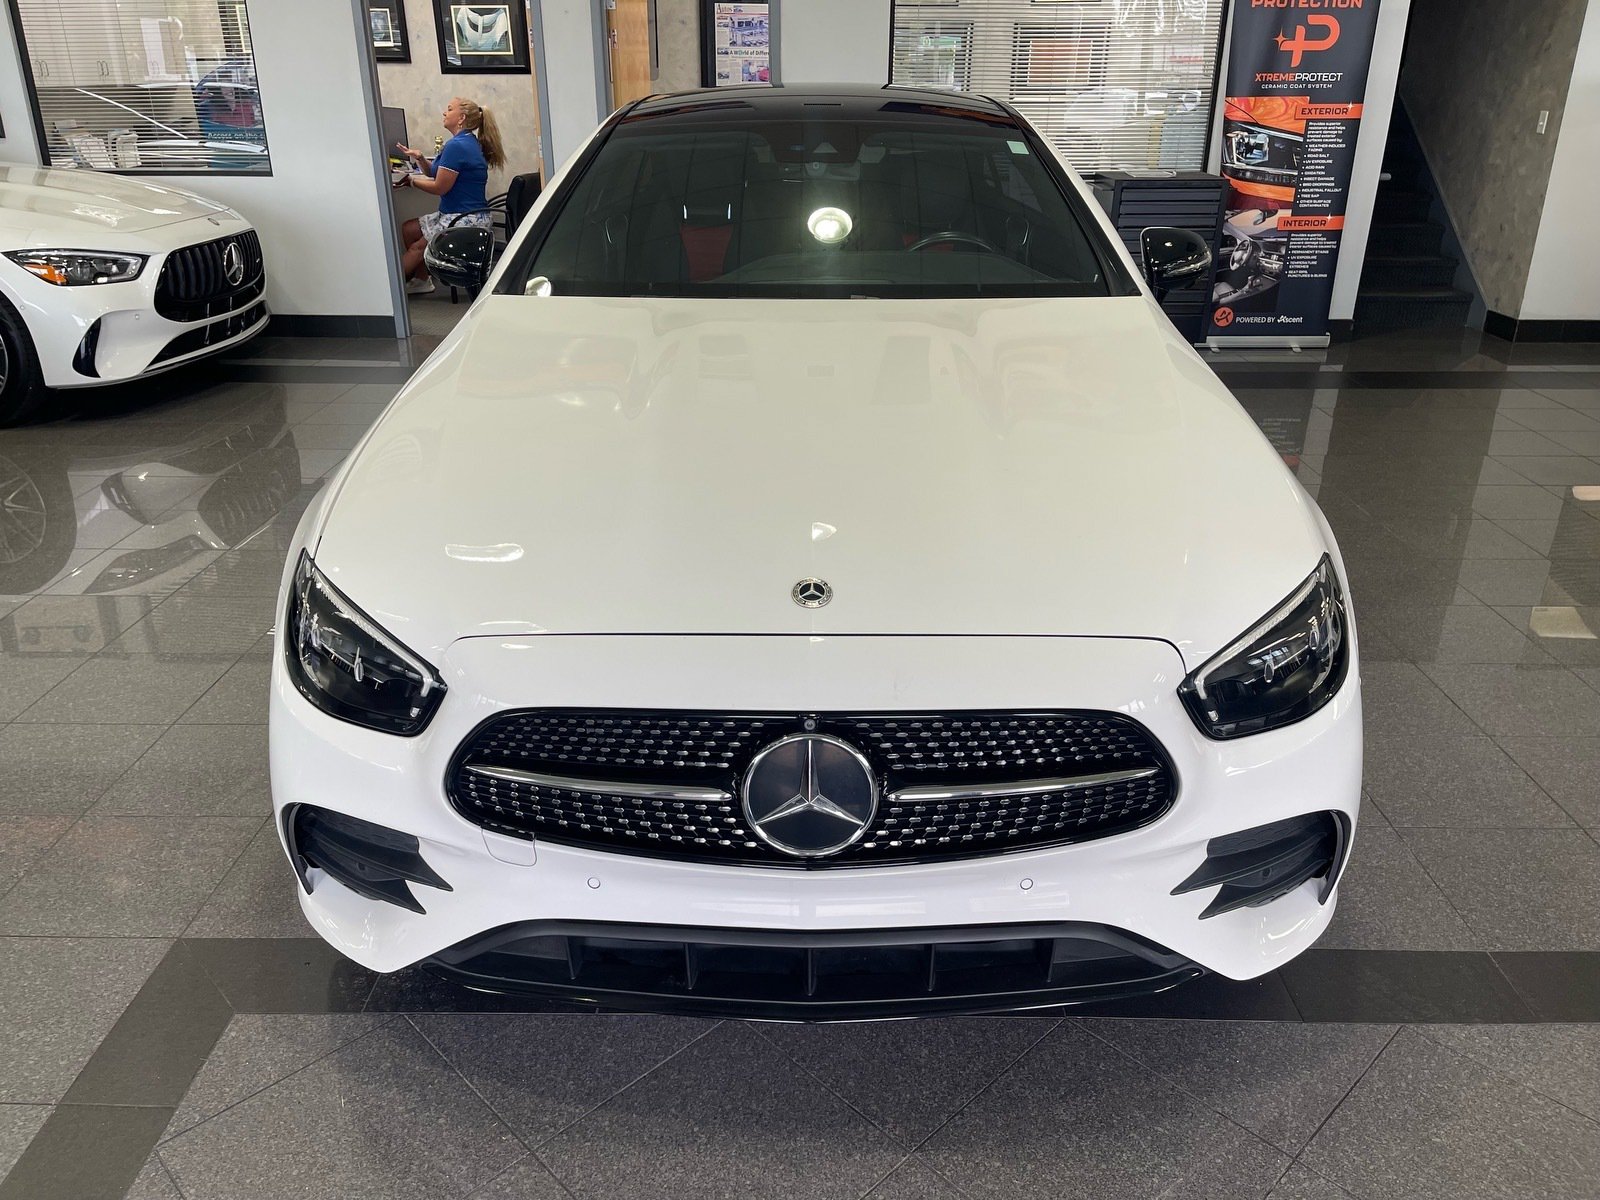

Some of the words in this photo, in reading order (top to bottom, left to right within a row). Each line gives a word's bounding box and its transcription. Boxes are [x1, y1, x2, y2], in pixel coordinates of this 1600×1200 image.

[1251, 0, 1362, 8] PROTECTION
[1255, 73, 1343, 82] XTREMEPROTECT
[1301, 107, 1349, 115] EXTERIOR
[1283, 219, 1327, 227] INTERIOR
